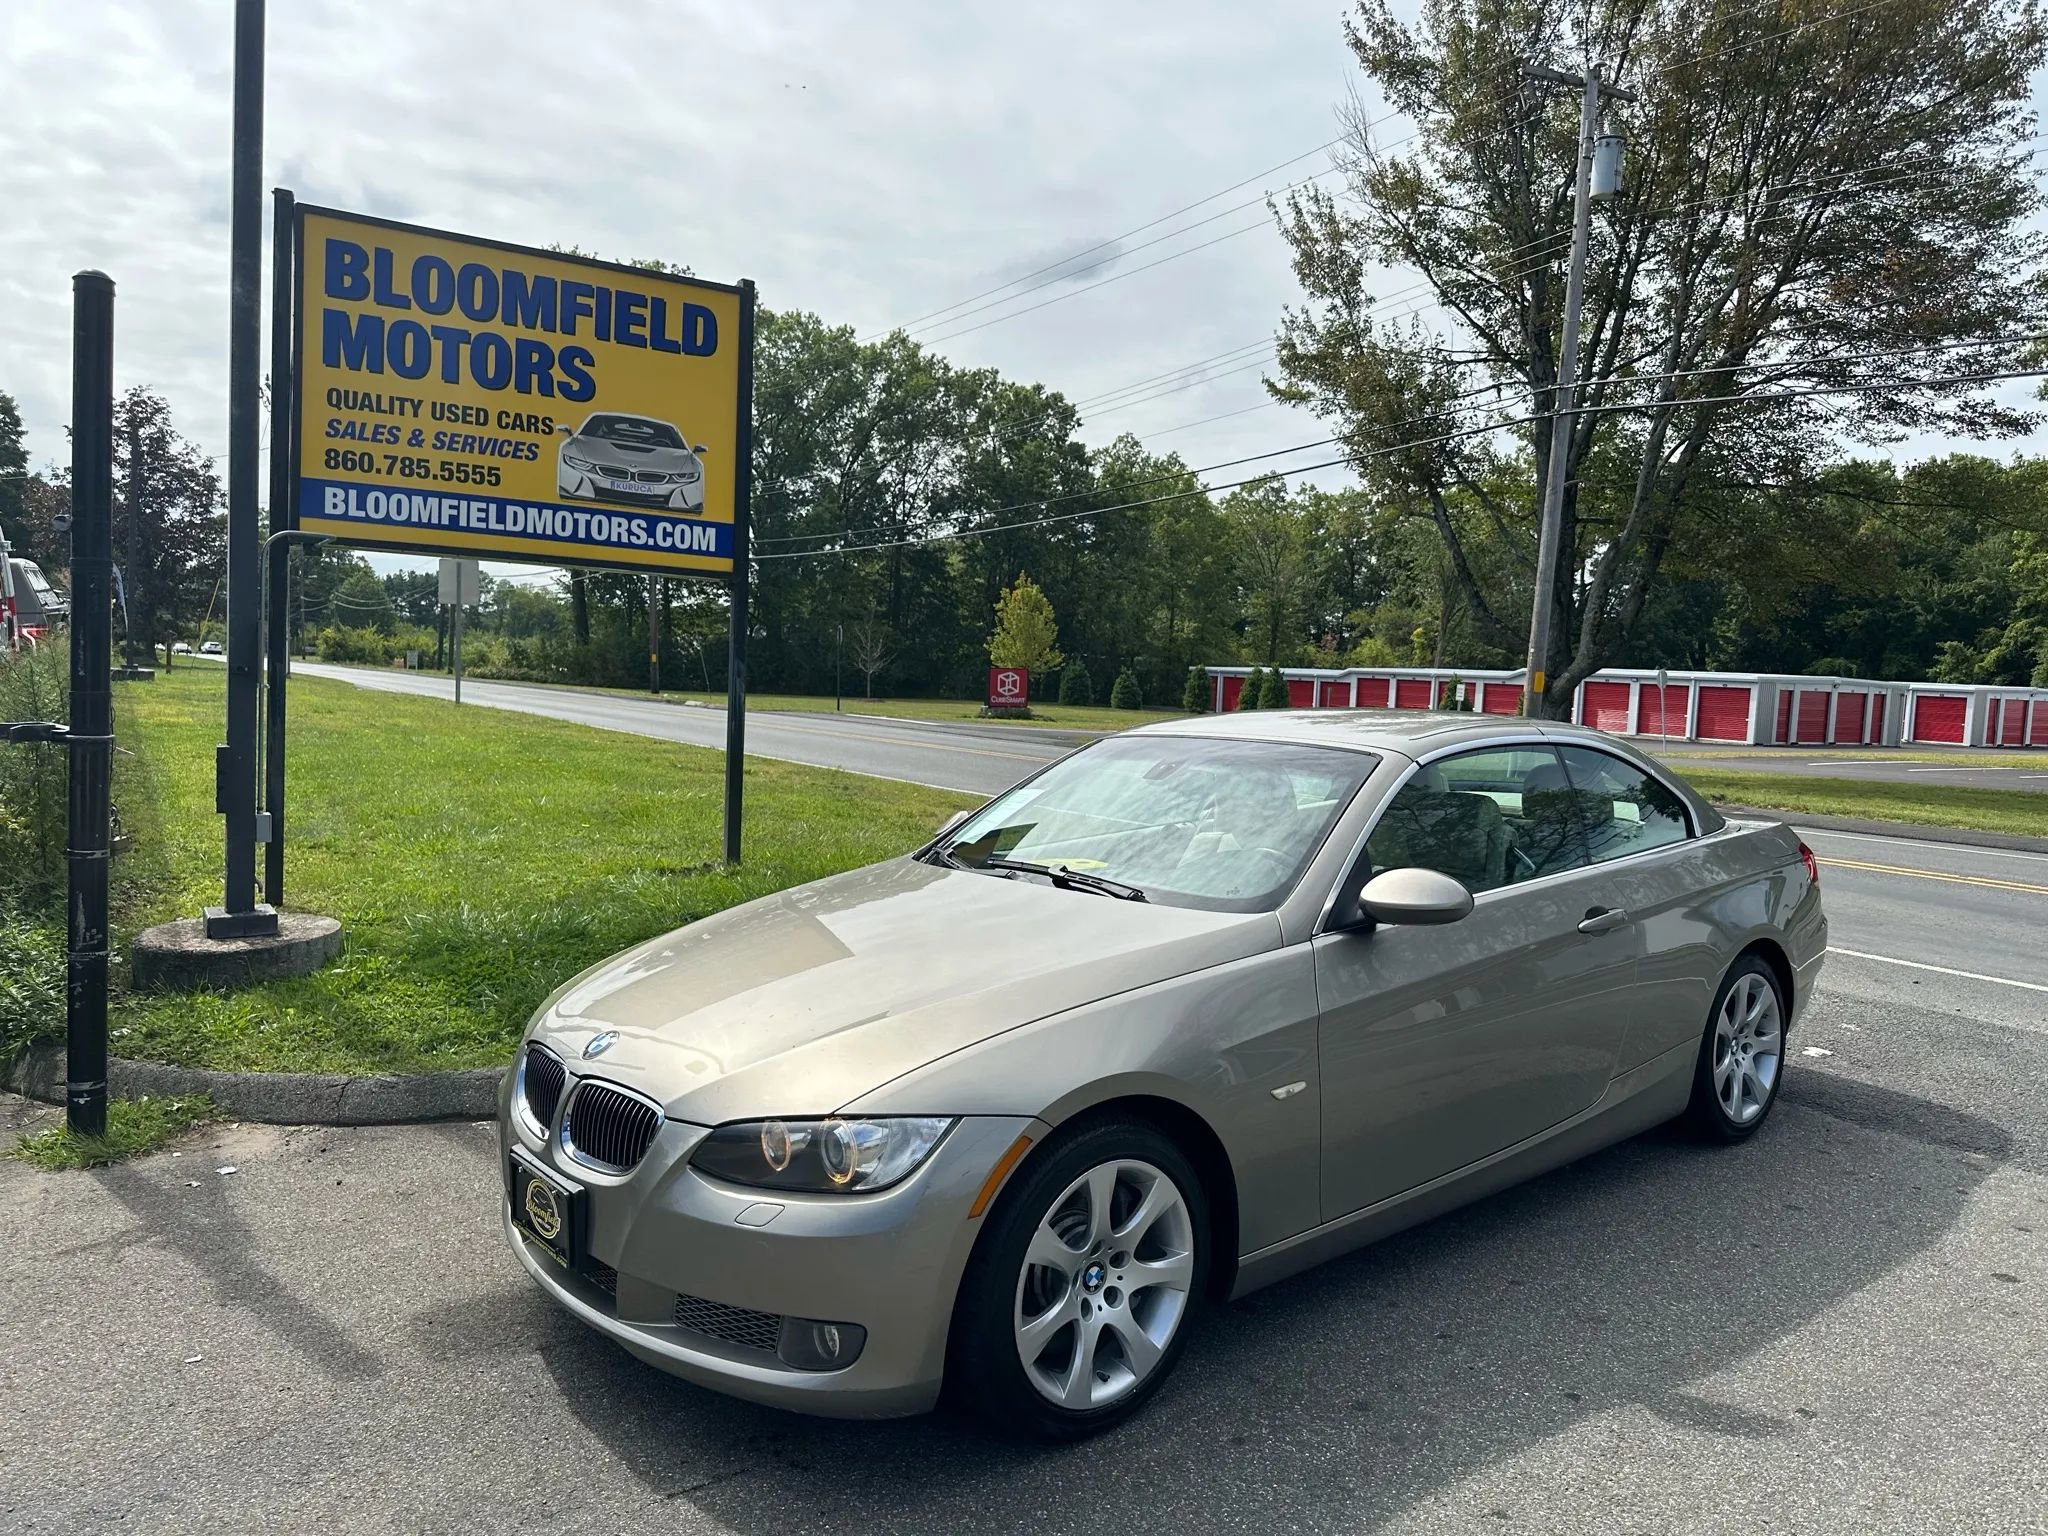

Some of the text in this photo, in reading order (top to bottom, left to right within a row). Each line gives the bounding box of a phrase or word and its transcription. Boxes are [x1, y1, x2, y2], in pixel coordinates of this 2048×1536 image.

[325, 238, 718, 357] BLOOMFIELD
[323, 308, 596, 402] MOTORS
[326, 387, 554, 435] QUALITY USED CARS
[324, 448, 501, 487] 860.785.5555
[325, 418, 539, 461] SALES & SERVICES
[324, 487, 717, 552] BLOOMFIELDMOTORS.COM
